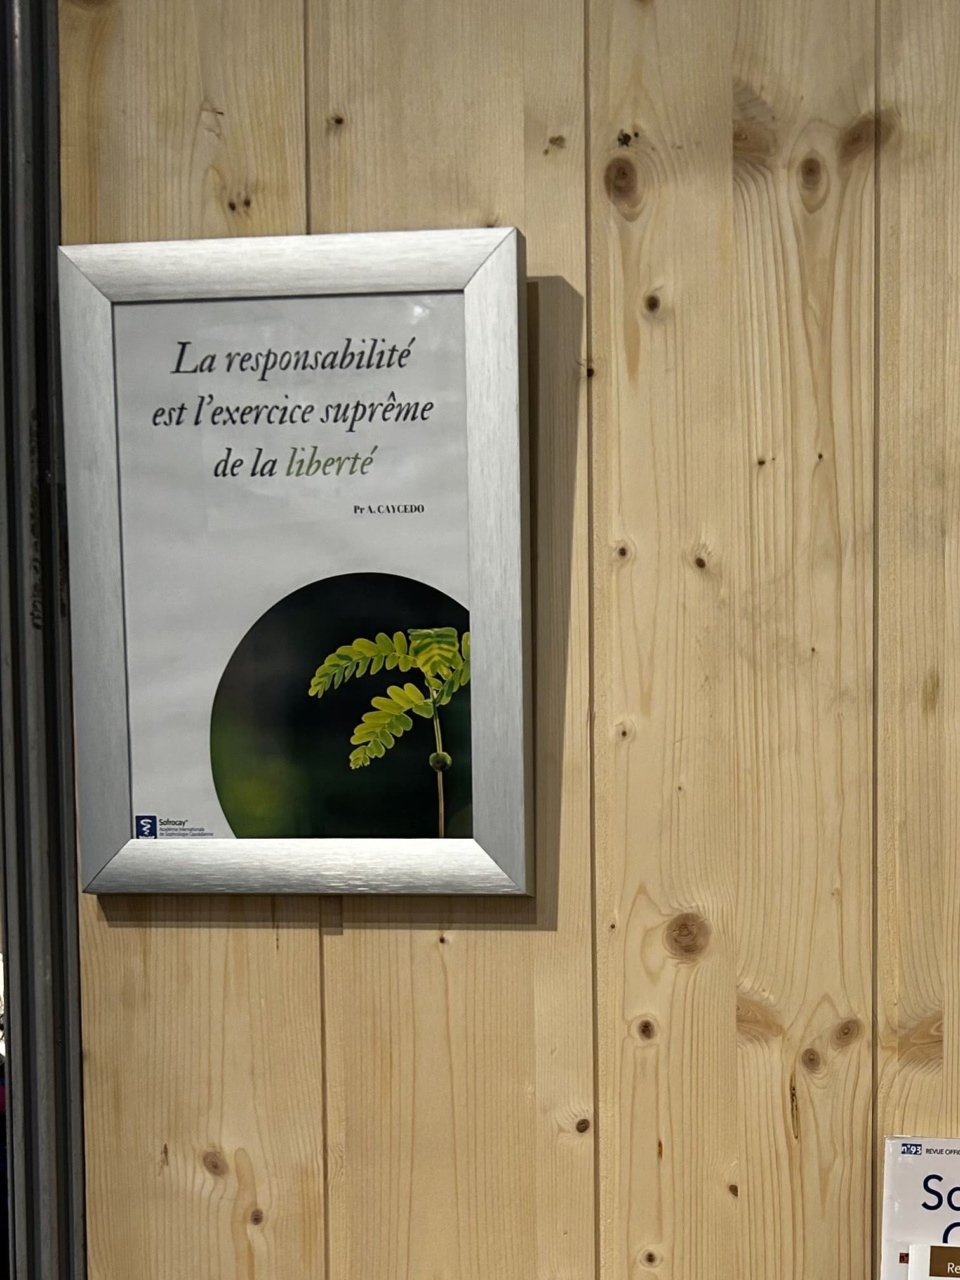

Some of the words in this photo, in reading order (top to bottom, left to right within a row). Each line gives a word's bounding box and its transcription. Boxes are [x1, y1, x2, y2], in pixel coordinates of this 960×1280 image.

[170, 341, 216, 375] La
[225, 337, 416, 382] responsabilité
[152, 404, 187, 427] est
[319, 390, 435, 433] suprême
[213, 448, 244, 478] de
[250, 448, 277, 477] la
[285, 445, 378, 477] liberté
[353, 504, 365, 514] Pr
[367, 504, 376, 514] A.
[377, 504, 425, 514] CAYCEDO
